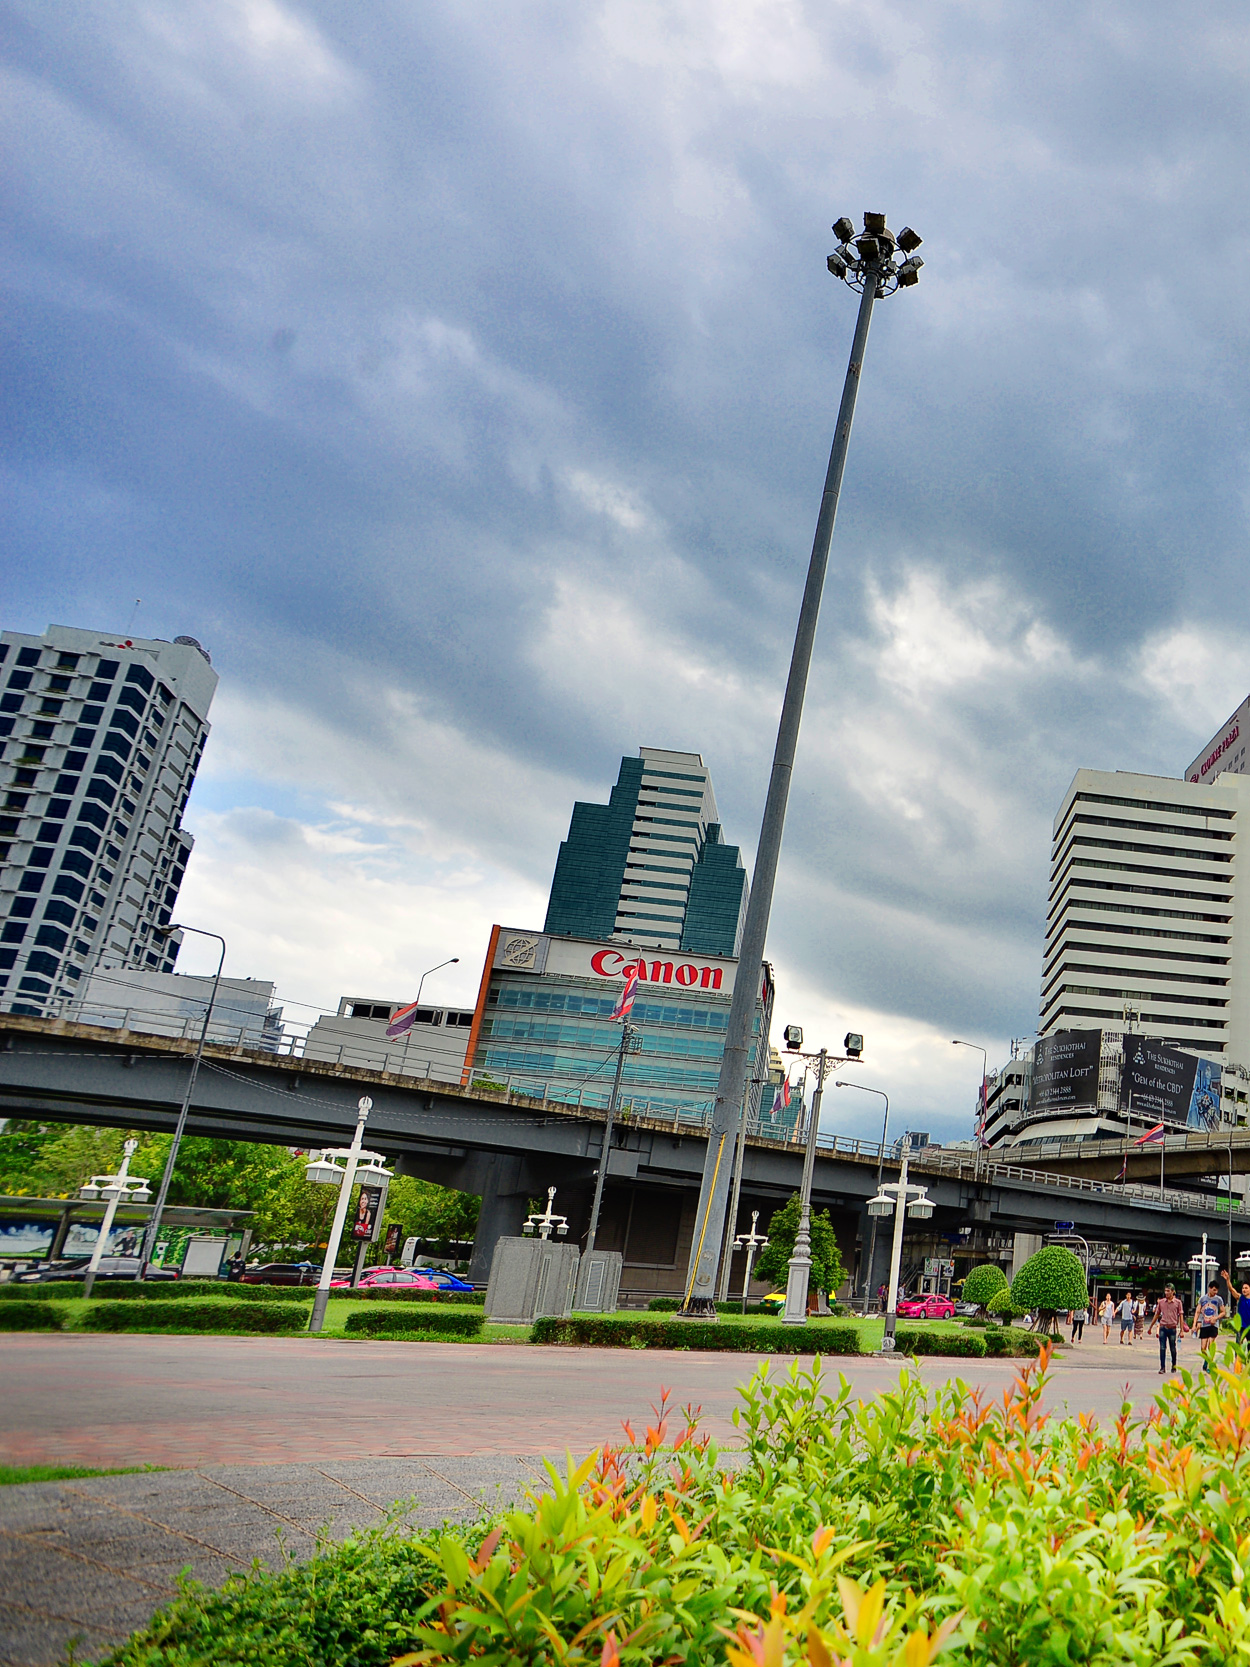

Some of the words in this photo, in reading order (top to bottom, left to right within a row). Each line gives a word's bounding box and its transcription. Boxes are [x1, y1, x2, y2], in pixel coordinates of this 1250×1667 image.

[591, 950, 723, 989] Canon
[1053, 1042, 1086, 1054] SUKHOTHAI
[1157, 1053, 1183, 1070] SUKHOTHAI
[1149, 1077, 1156, 1087] of
[1156, 1079, 1165, 1090] the
